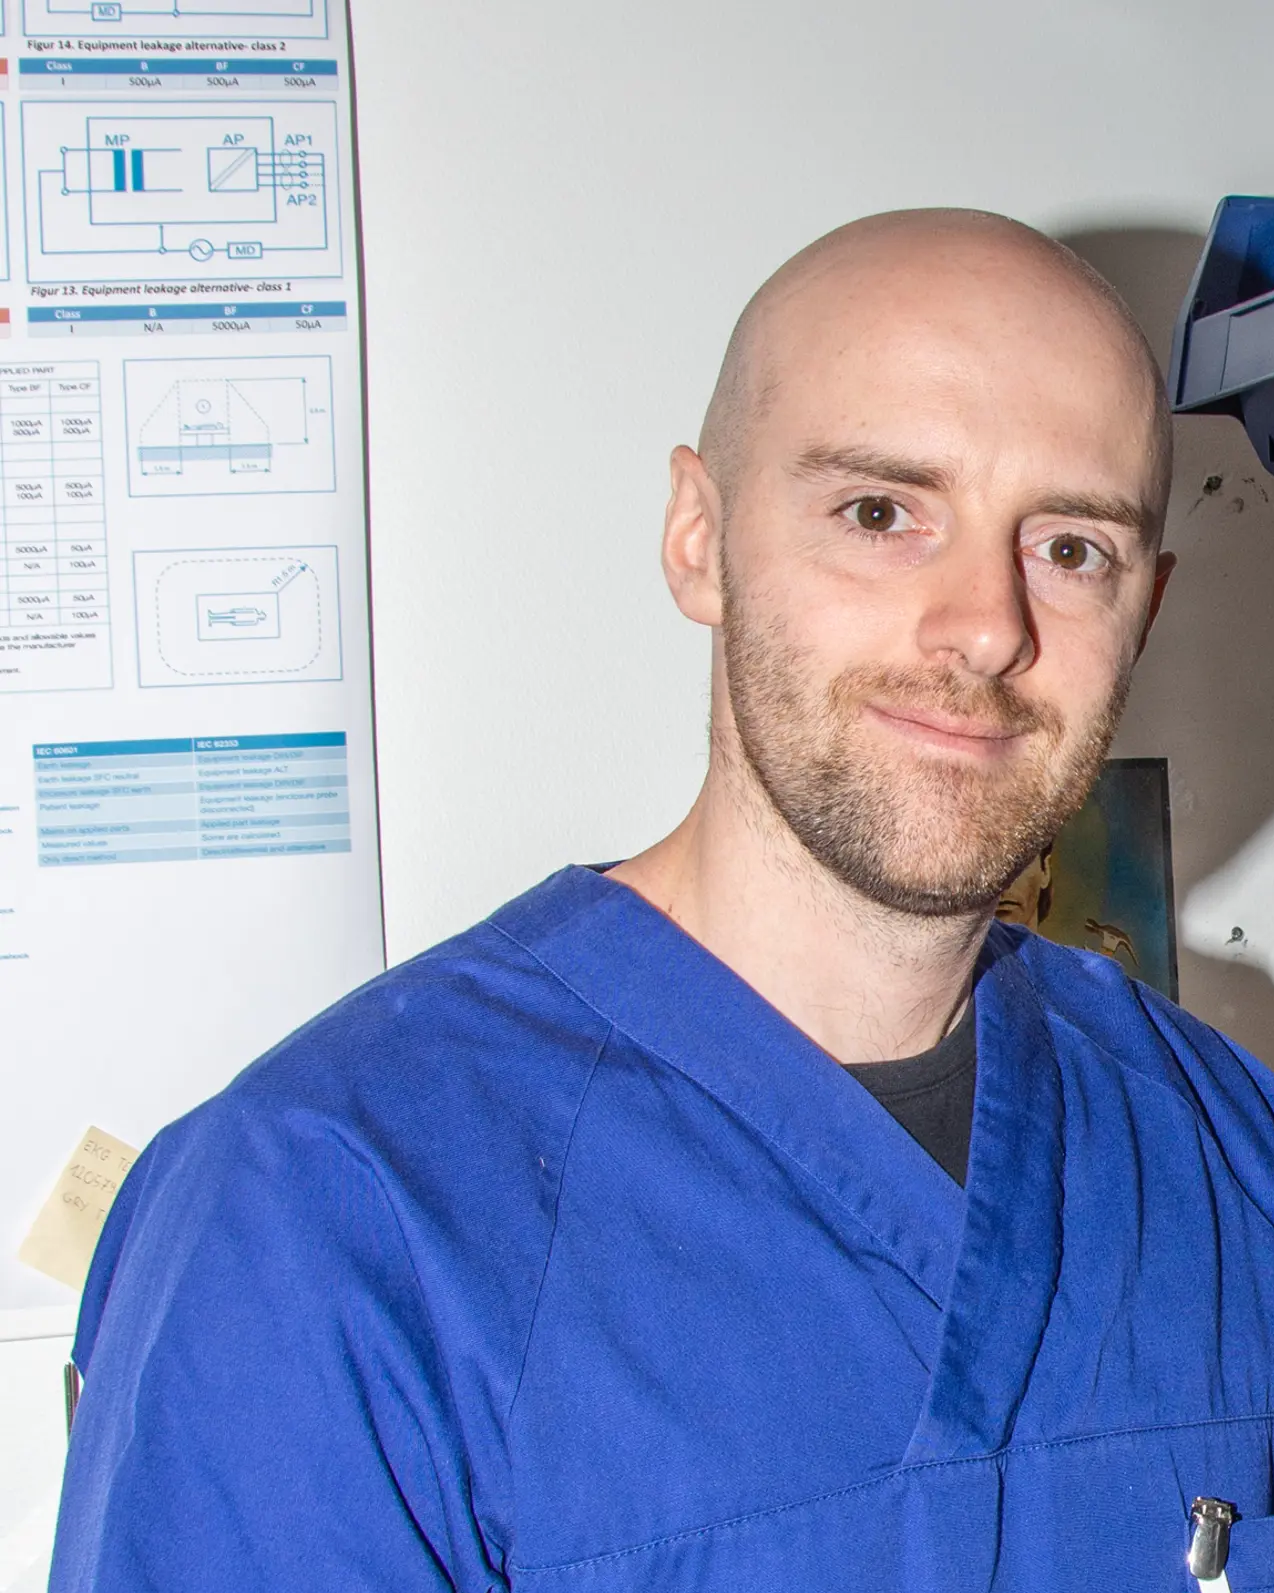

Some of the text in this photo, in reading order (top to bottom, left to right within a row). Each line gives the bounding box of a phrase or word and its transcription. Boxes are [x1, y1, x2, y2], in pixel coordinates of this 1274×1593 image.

[27, 40, 54, 52] Figur
[58, 41, 74, 50] 14.
[78, 40, 137, 52] Equipment
[140, 41, 182, 52] leakage
[251, 41, 277, 51] class
[279, 41, 286, 51] 2
[46, 61, 306, 72] Class B BF CF
[104, 134, 313, 146] MP AP AP1
[286, 194, 317, 206] AP2
[31, 286, 59, 298] Figur
[62, 286, 79, 296] 13.
[82, 285, 141, 298] Equipment
[144, 284, 186, 296] leakage
[256, 282, 282, 292] class
[285, 282, 291, 292] 1
[54, 304, 314, 320] Class B BF CF
[144, 323, 164, 333] N/A
